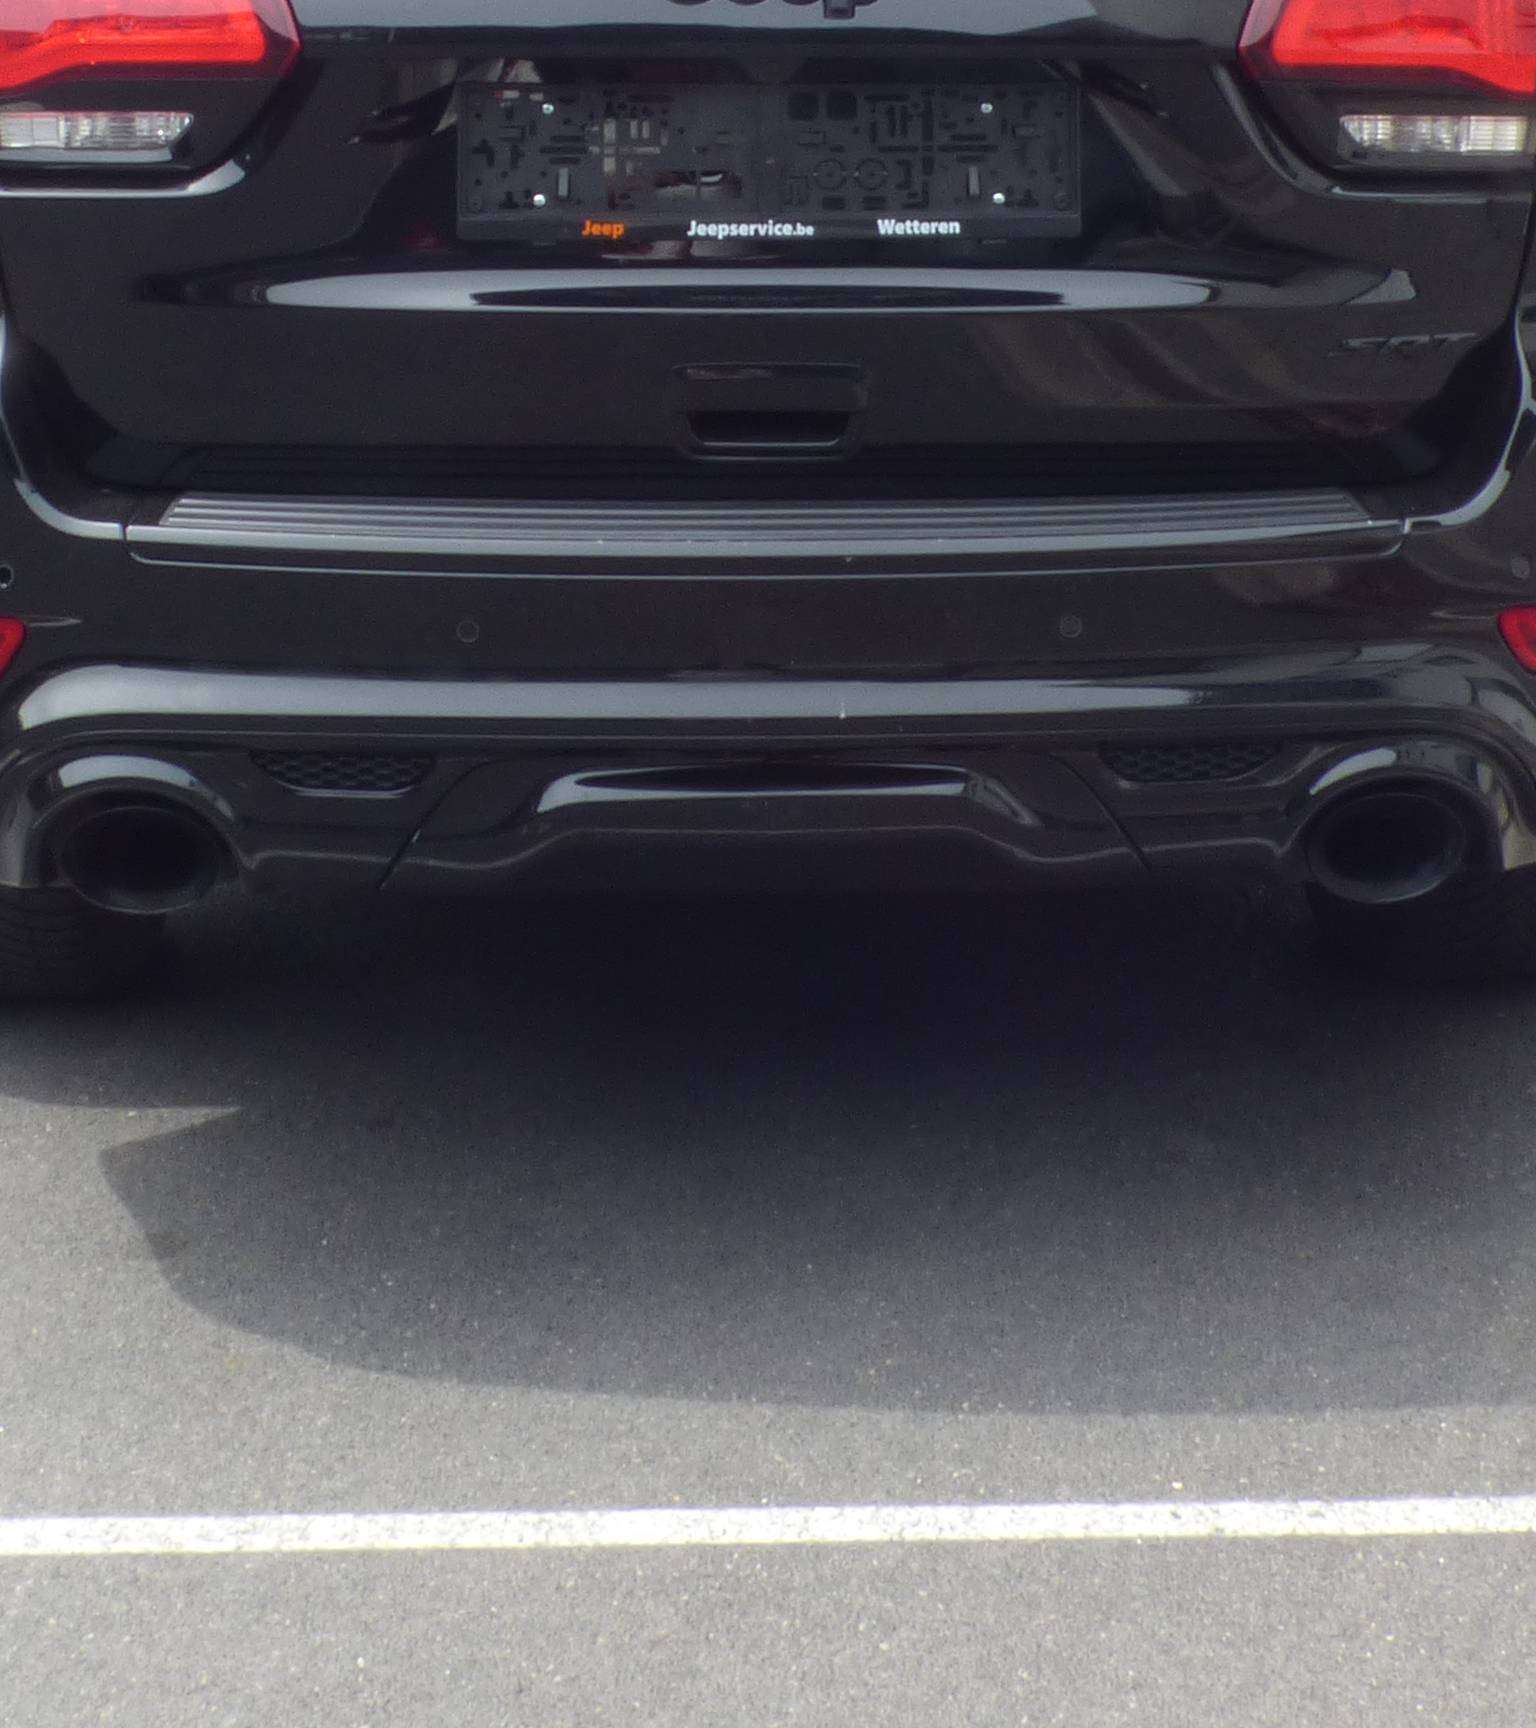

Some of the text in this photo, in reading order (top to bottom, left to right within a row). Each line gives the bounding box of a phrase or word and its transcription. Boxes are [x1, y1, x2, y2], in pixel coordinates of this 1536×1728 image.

[581, 217, 961, 240] Jeep Jeepservice.be Wetteren
